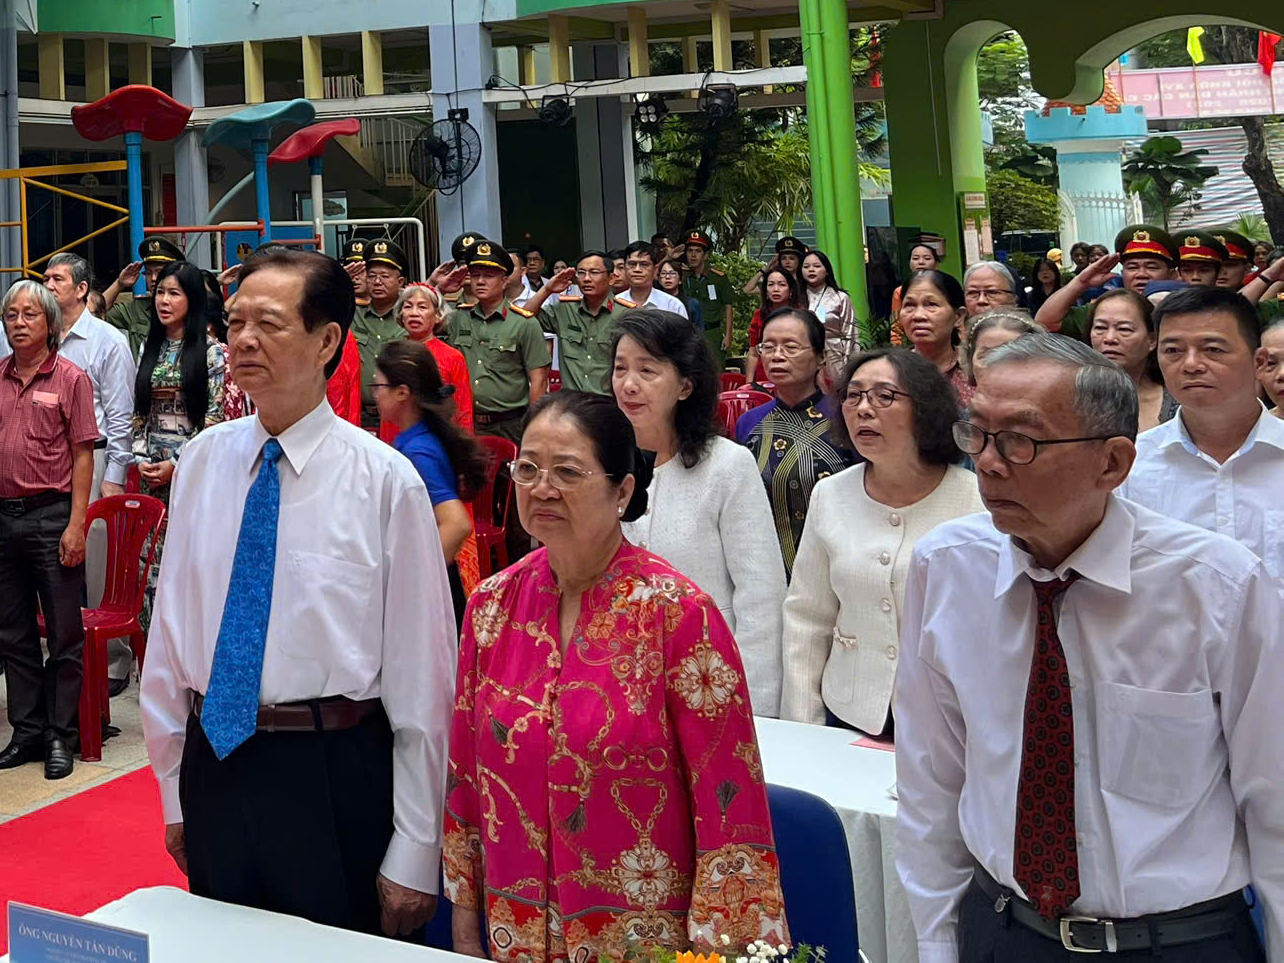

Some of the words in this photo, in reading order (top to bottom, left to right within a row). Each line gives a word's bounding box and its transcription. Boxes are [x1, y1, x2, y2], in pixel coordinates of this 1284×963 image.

[18, 922, 40, 940] ÔNG
[42, 930, 82, 949] NGUYỄN
[107, 945, 137, 962] DŨNG
